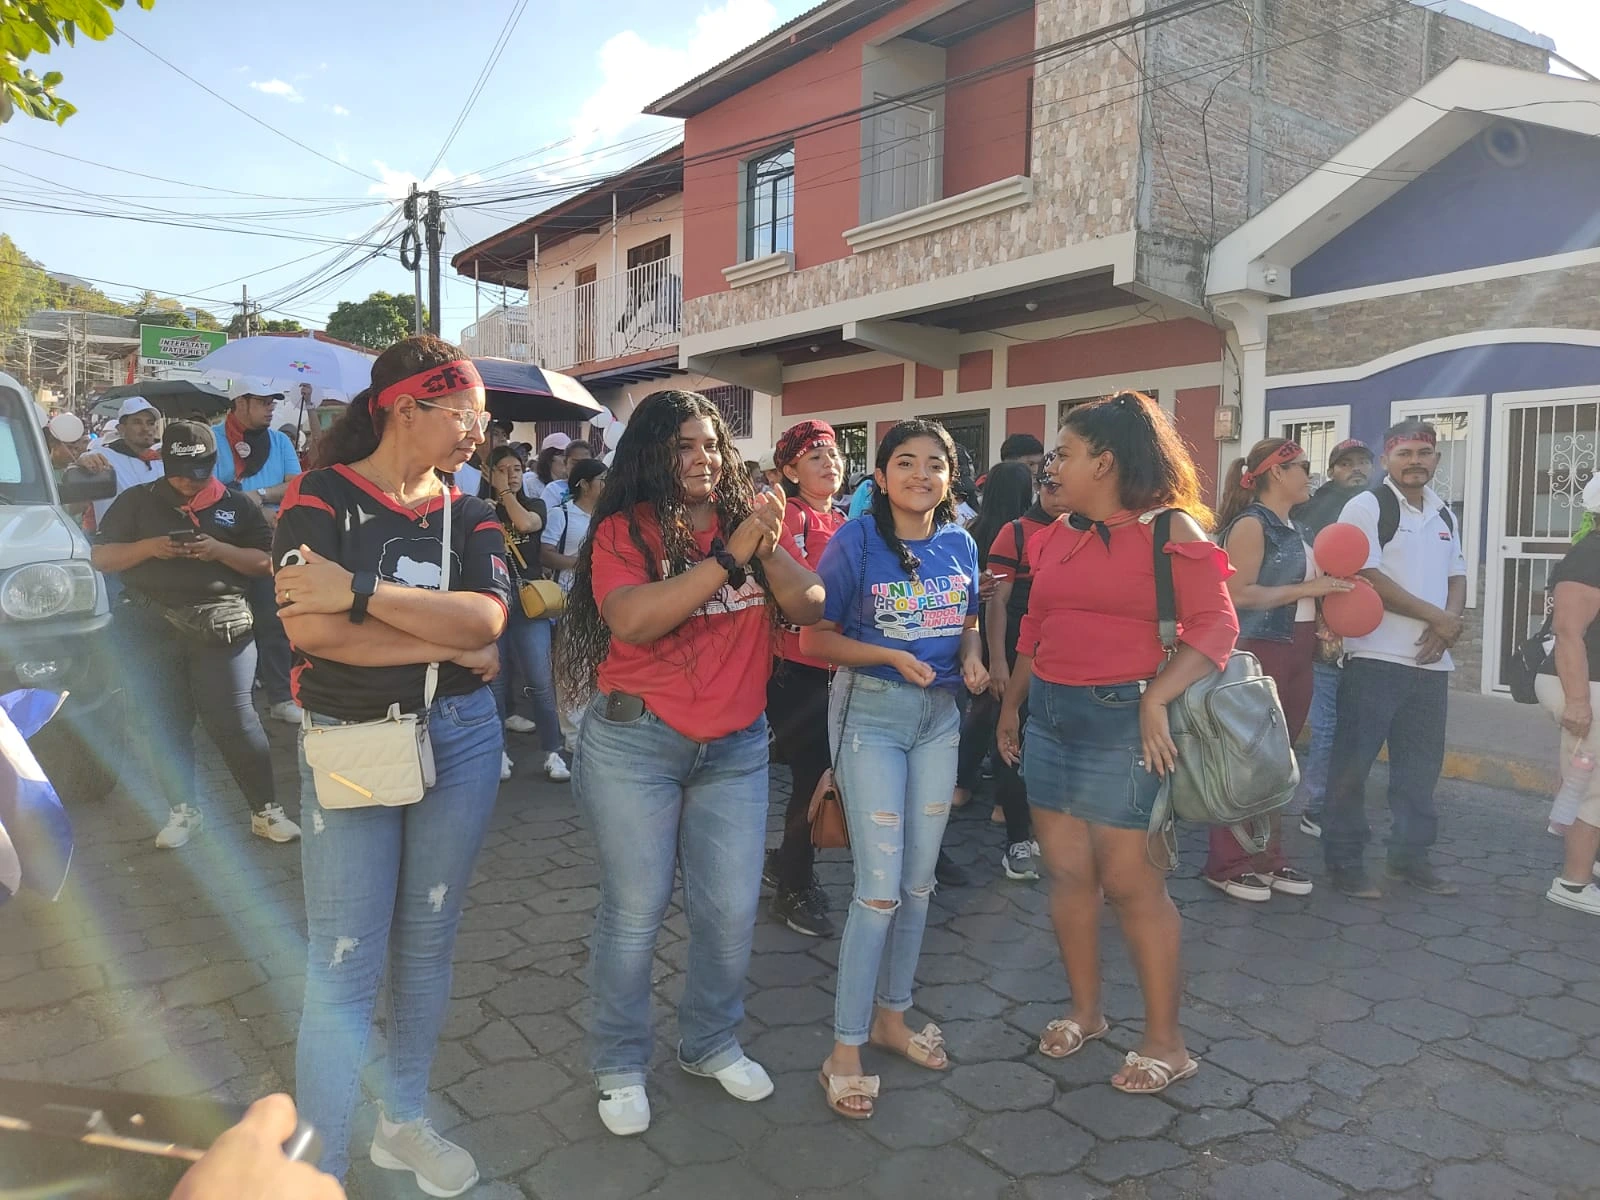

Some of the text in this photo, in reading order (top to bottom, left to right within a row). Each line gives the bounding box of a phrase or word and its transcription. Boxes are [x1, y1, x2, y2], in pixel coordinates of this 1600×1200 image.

[160, 339, 210, 350] INTERSTATE
[161, 346, 205, 355] BATTERIES
[872, 577, 951, 596] UNIDAD
[875, 590, 967, 610] PROSPERIDA
[923, 608, 956, 619] TODOS
